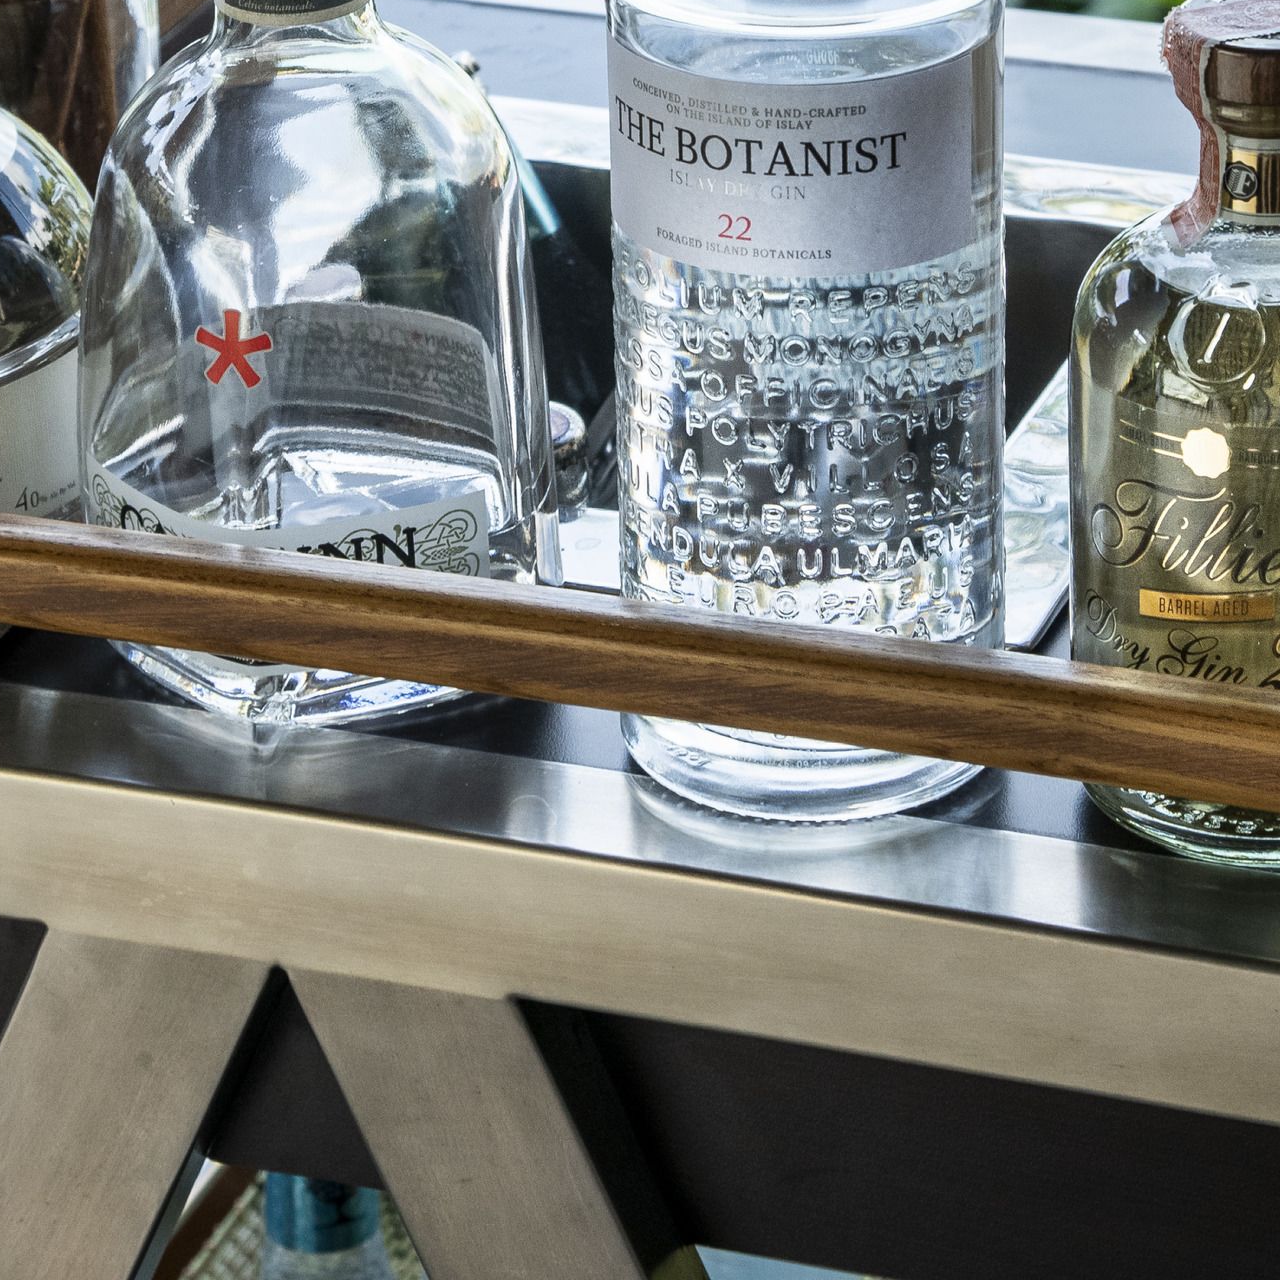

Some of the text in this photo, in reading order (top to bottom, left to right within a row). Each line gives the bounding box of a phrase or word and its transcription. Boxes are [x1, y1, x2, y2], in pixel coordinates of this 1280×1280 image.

[632, 77, 867, 119] CONCEIVED, DISTILLED & HAND-CRAFTED
[666, 103, 813, 131] ON THE ISLAND OF ISLAY
[615, 95, 907, 177] THE BOTANIST
[770, 185, 807, 200] GIN
[717, 213, 753, 241] 22
[656, 226, 833, 261] FORAGED ISLAND BOTANICALS
[1158, 596, 1250, 617] BARREL AGED
[1155, 628, 1249, 685] Gin
